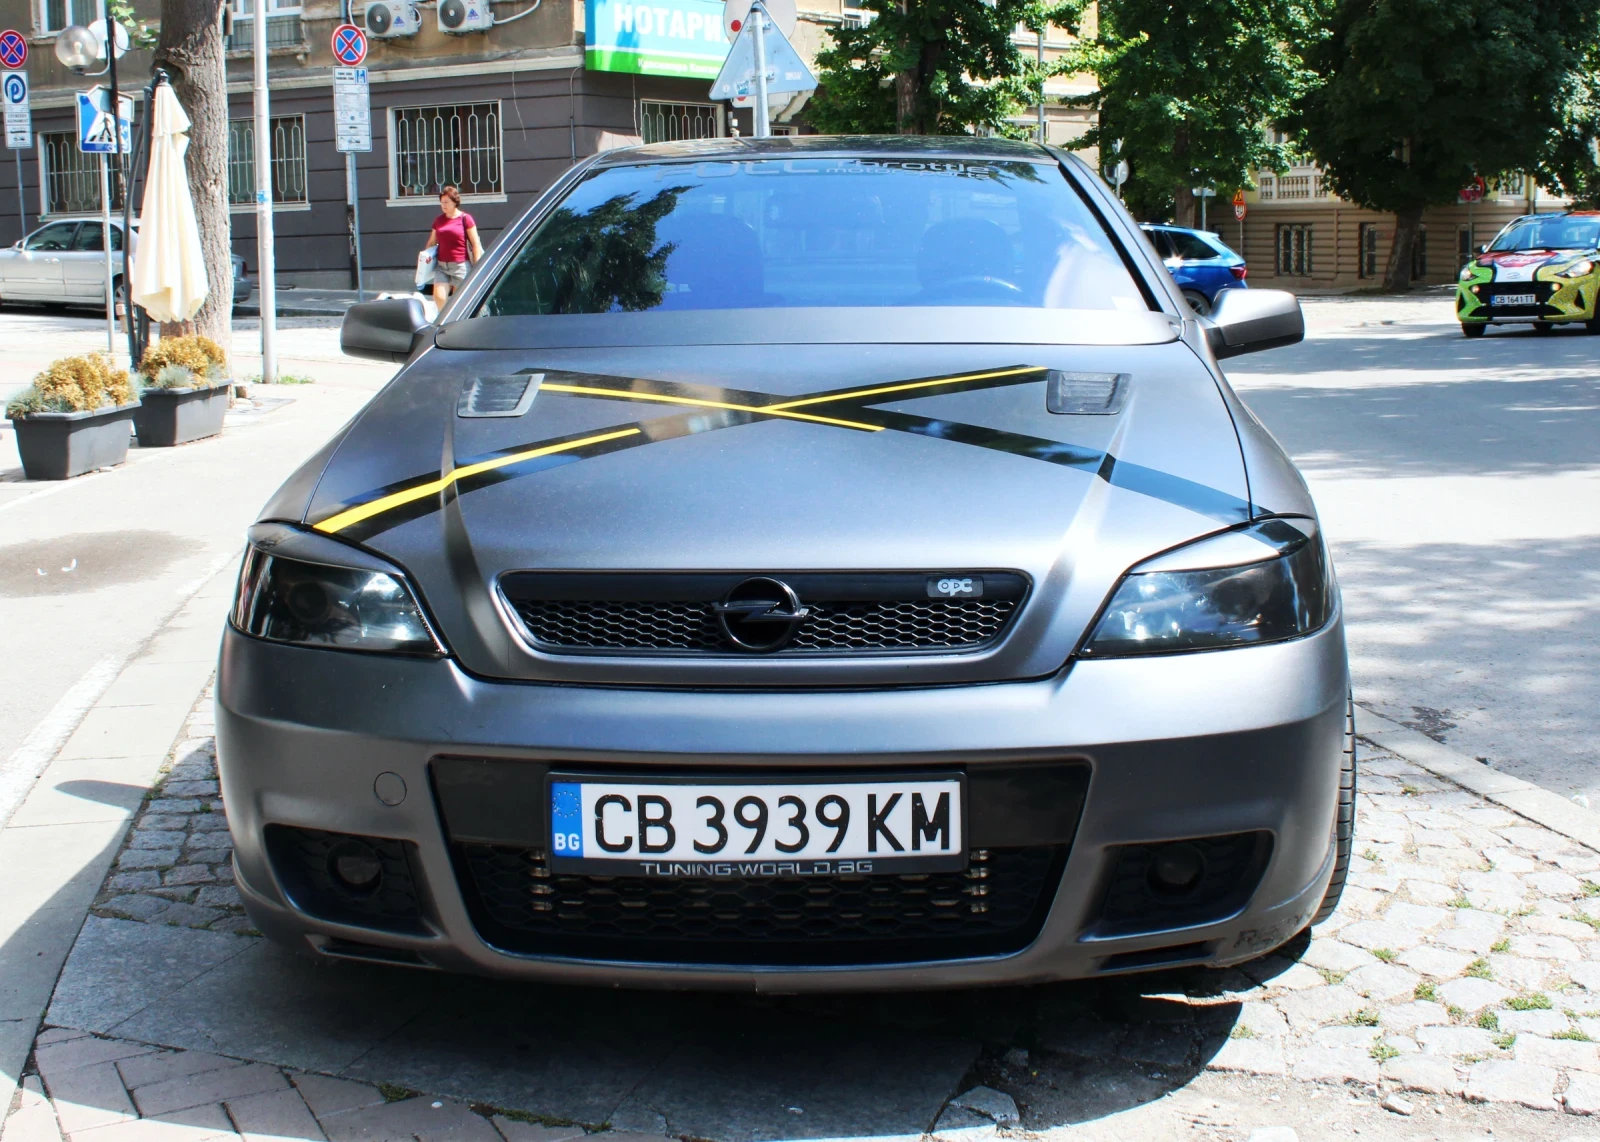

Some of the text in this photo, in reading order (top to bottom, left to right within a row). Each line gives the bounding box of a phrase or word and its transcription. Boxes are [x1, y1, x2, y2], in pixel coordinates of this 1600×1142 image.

[613, 2, 731, 44] НОТАРИ
[1506, 296, 1523, 304] 1641
[554, 792, 950, 855] BG CB 3939 KM
[639, 860, 873, 876] TUNING-WORLD.BG
